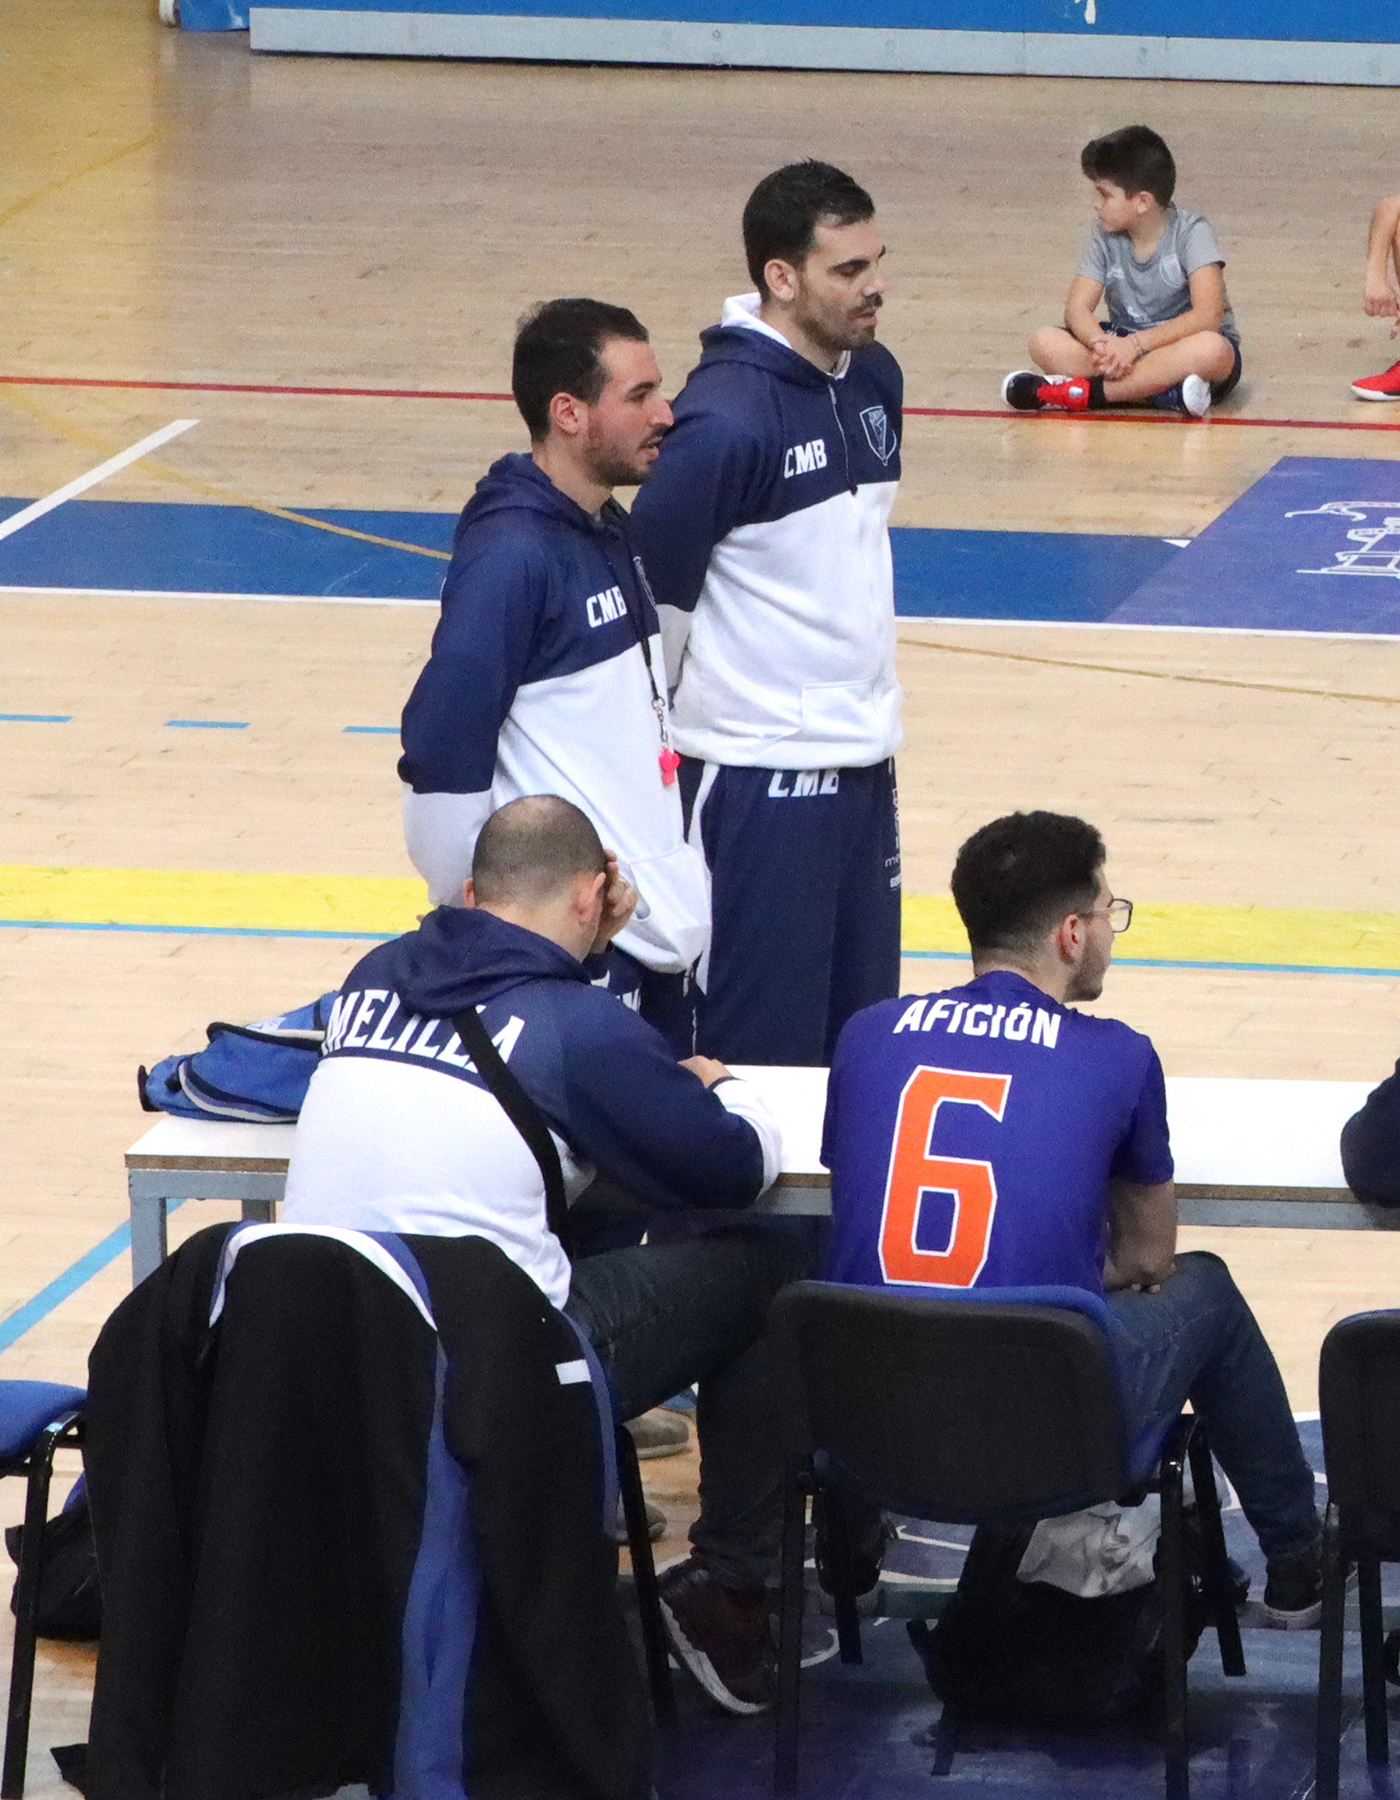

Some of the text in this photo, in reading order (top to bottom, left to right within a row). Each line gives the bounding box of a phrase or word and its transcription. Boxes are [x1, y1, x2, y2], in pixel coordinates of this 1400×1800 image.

[784, 439, 828, 479] CMB
[586, 585, 628, 629] CMB
[321, 989, 525, 1074] MELILLA
[893, 998, 1061, 1049] AFICIÓN
[877, 1064, 1012, 1290] 6
